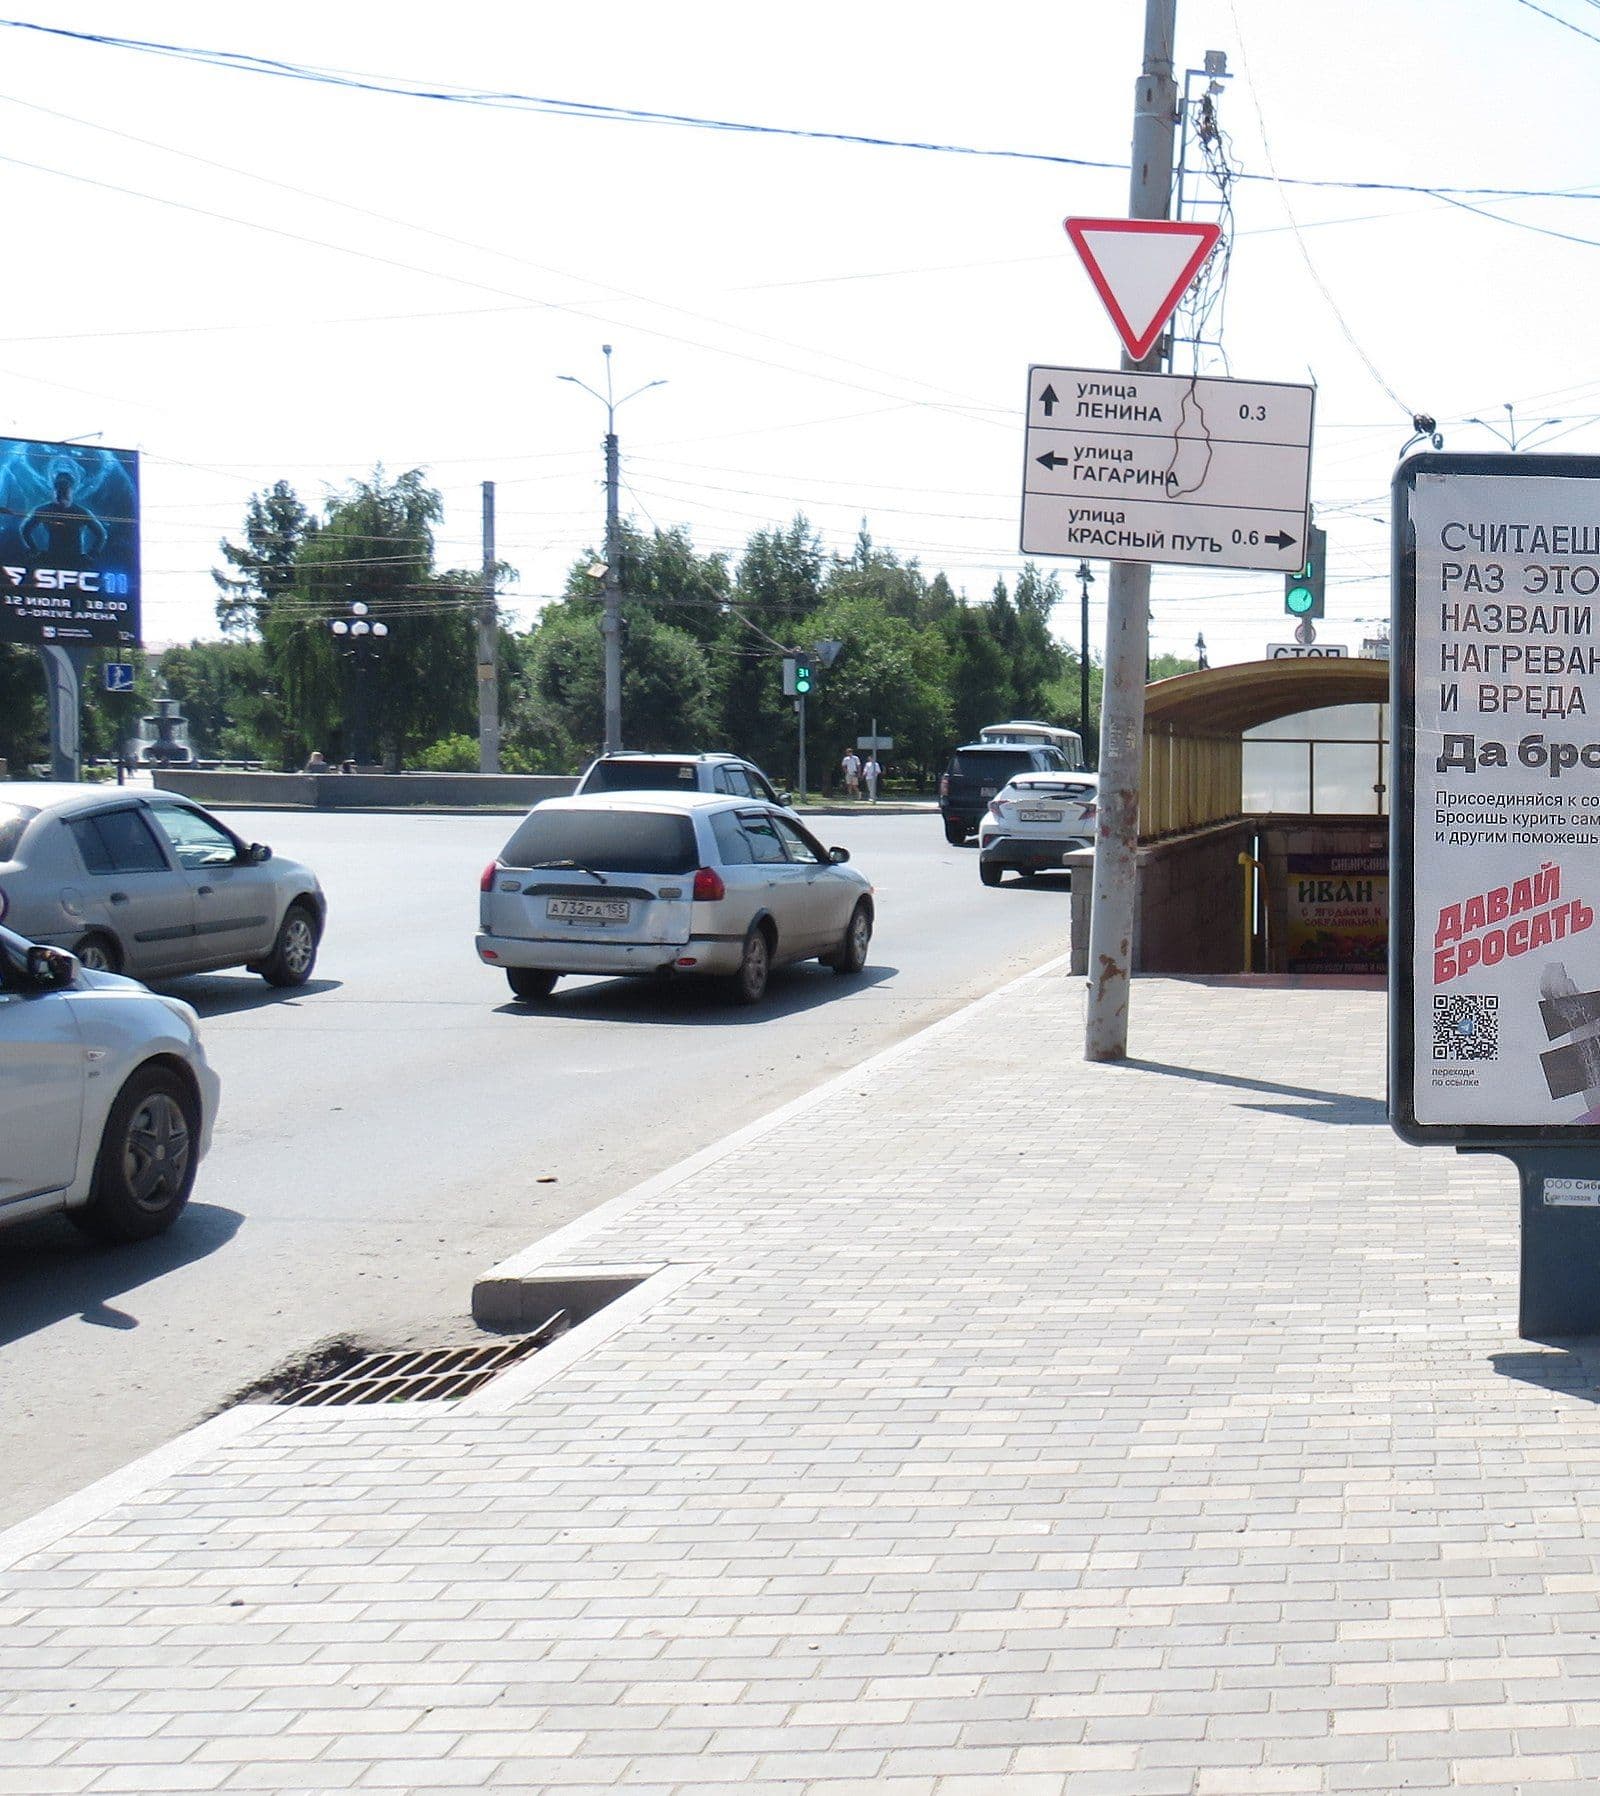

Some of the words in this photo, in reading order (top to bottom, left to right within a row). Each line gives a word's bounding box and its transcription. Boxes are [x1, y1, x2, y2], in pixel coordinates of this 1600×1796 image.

[1077, 382, 1137, 399] улица
[1076, 402, 1162, 422] ЛЕНИНА
[1239, 404, 1267, 421] 0.3
[1073, 445, 1133, 461] улица
[1073, 465, 1179, 486] ГАГАРИНА
[1068, 508, 1125, 524] улица
[1068, 528, 1165, 549] КРАСНЫЙ
[1171, 535, 1223, 553] ПУТЬ
[1232, 529, 1259, 545] 0.6
[34, 568, 100, 592] SFC
[1442, 562, 1505, 594] РАЗ
[1523, 564, 1600, 595] ЭТО
[25, 596, 71, 608] ИЮЛЯ
[85, 600, 128, 611] 18:00
[17, 608, 72, 619] G-DRIVE
[74, 611, 118, 621] АРЕНА
[1441, 603, 1591, 635] НАЗВАЛИ
[1441, 683, 1459, 712] И
[1478, 684, 1586, 719] ВРЕДА
[1436, 734, 1508, 773] Да
[1435, 791, 1563, 808] Присоединяйся
[1568, 794, 1577, 806] к
[1435, 809, 1508, 827] Бросишь
[1512, 812, 1567, 828] курить
[1435, 831, 1445, 842] и
[1449, 830, 1507, 846] другим
[1434, 861, 1560, 949] ДАВАЙ
[1433, 899, 1594, 985] БРОСАТЬ
[1432, 1068, 1475, 1077] переходи
[1432, 1079, 1443, 1087] по
[1445, 1079, 1480, 1087] ссылке
[1546, 1179, 1572, 1190] ООО
